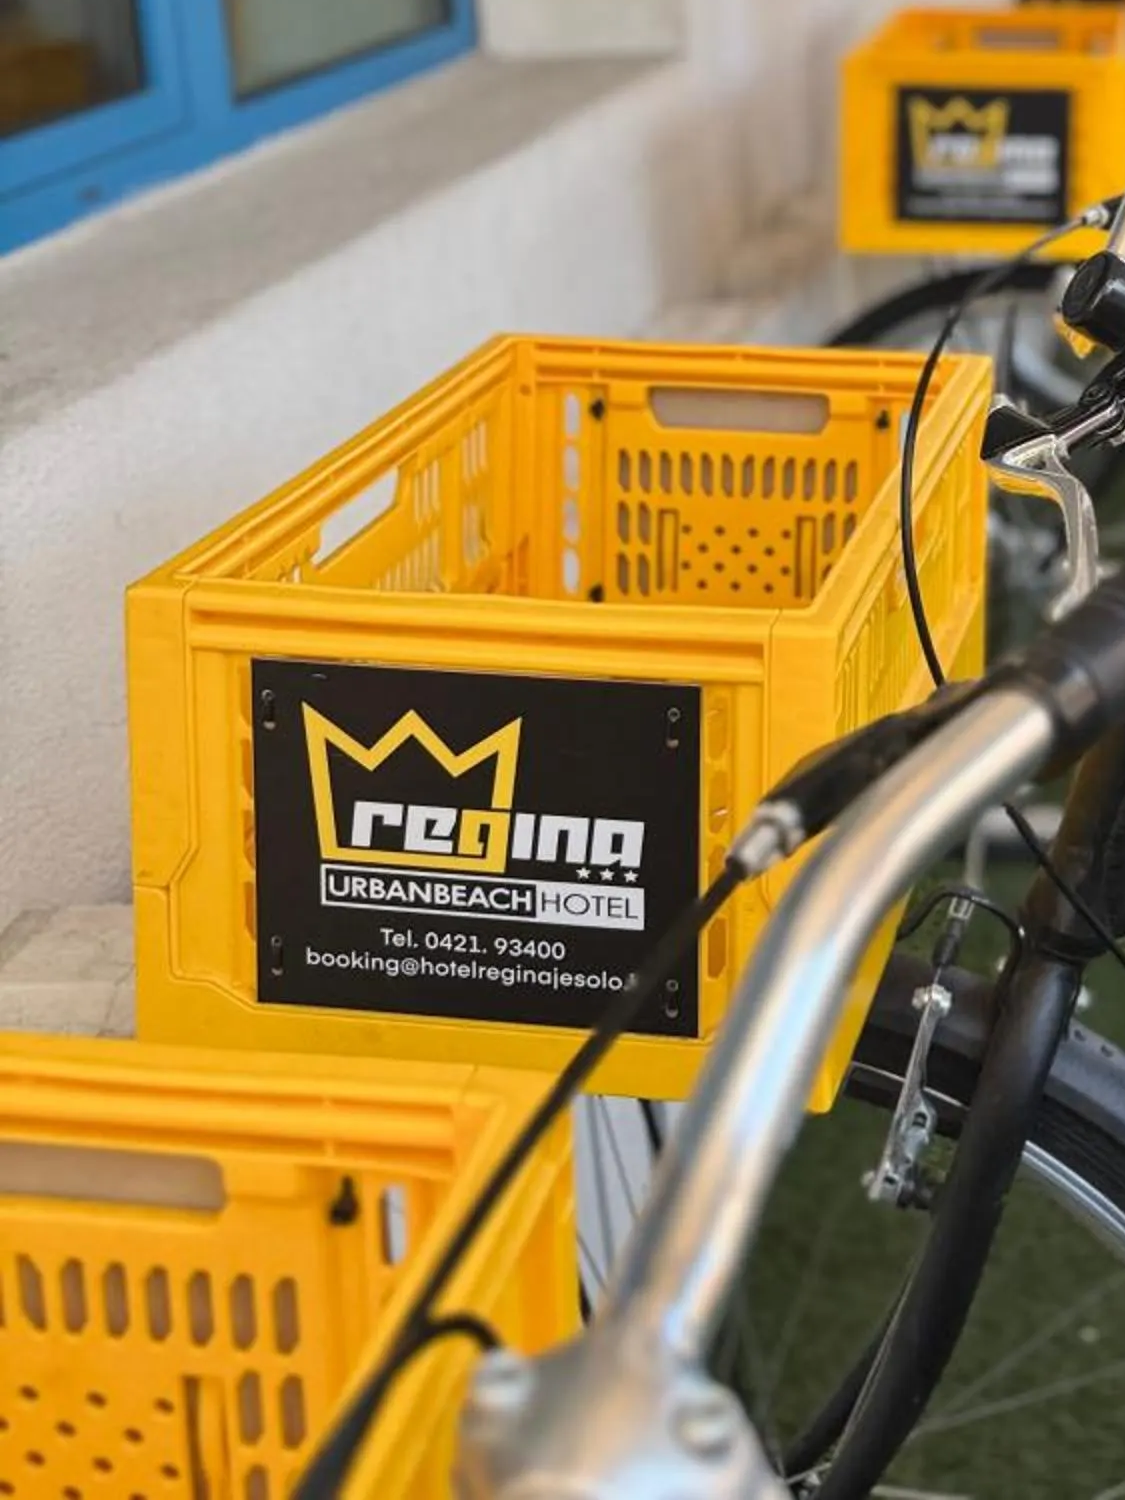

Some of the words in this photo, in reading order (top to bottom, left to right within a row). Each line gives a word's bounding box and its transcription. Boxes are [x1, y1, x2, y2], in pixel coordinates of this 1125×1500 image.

[351, 800, 645, 871] regina
[541, 891, 639, 920] HOTEL
[380, 927, 419, 948] Tel.
[425, 931, 487, 954] 0421.
[494, 937, 566, 961] 93400
